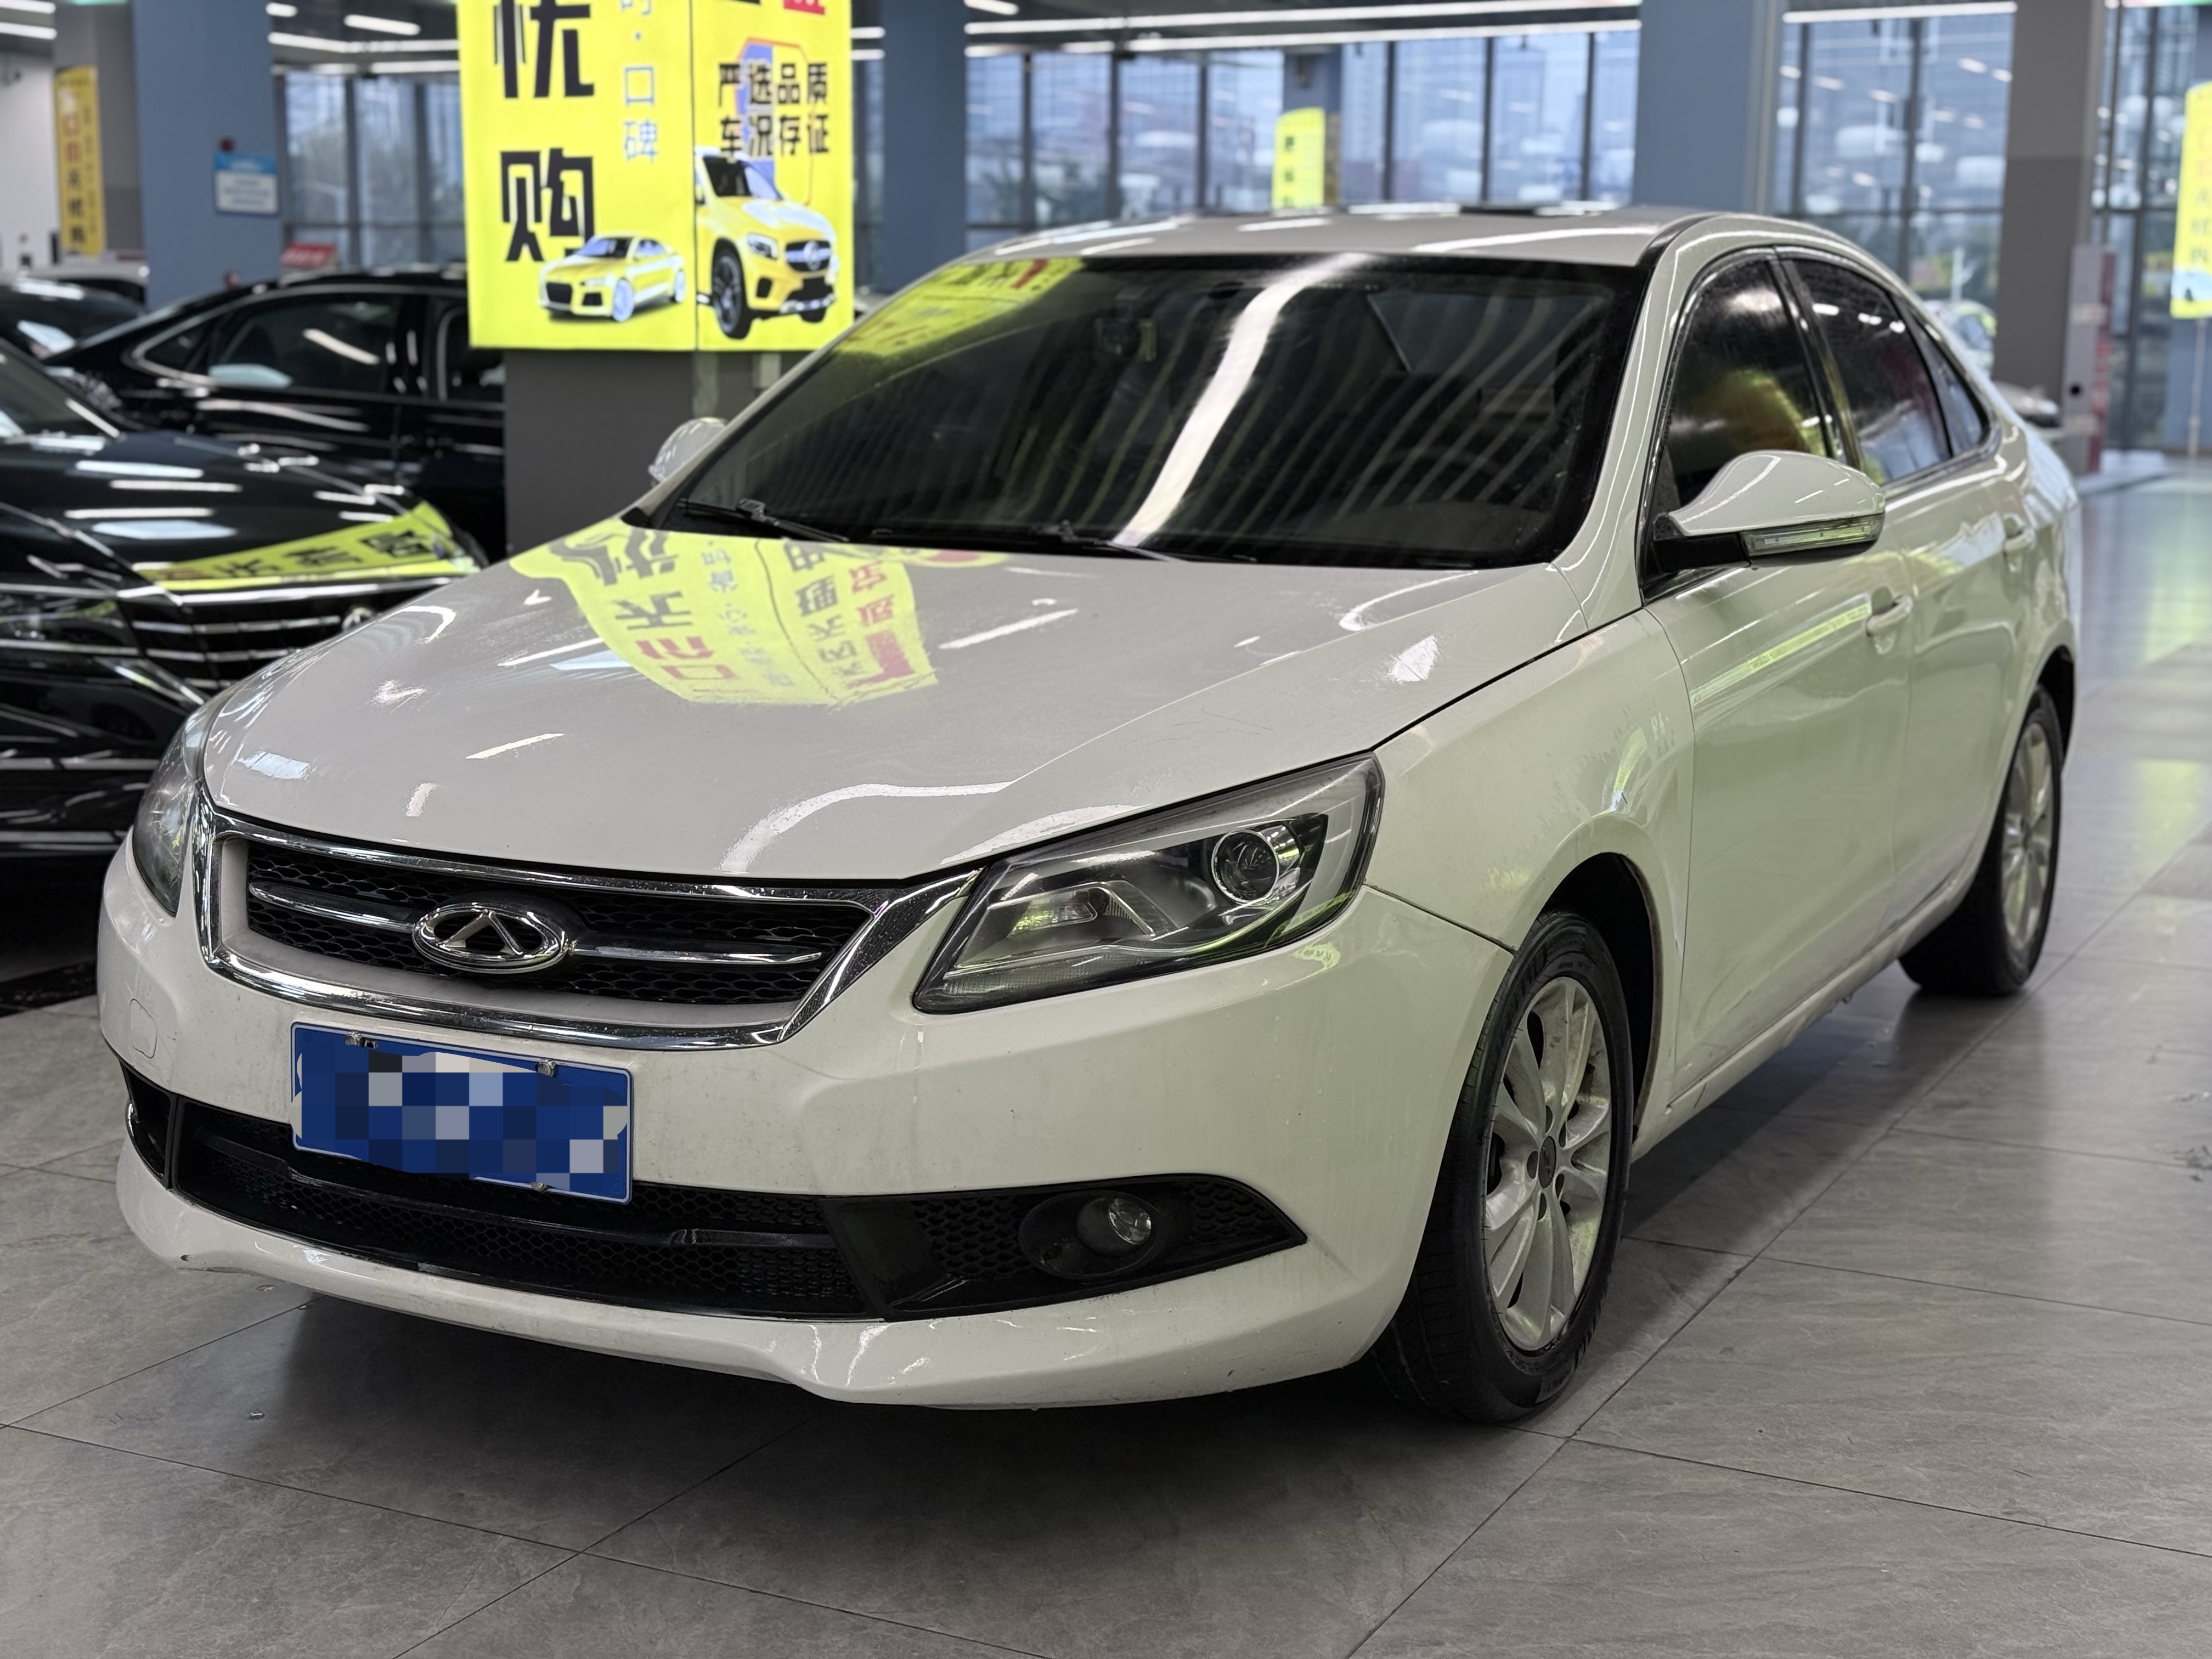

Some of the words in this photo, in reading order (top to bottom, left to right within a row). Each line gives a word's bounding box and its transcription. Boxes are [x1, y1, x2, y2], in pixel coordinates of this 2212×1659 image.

[719, 62, 827, 107] 严选品质
[720, 114, 830, 162] 车况存证
